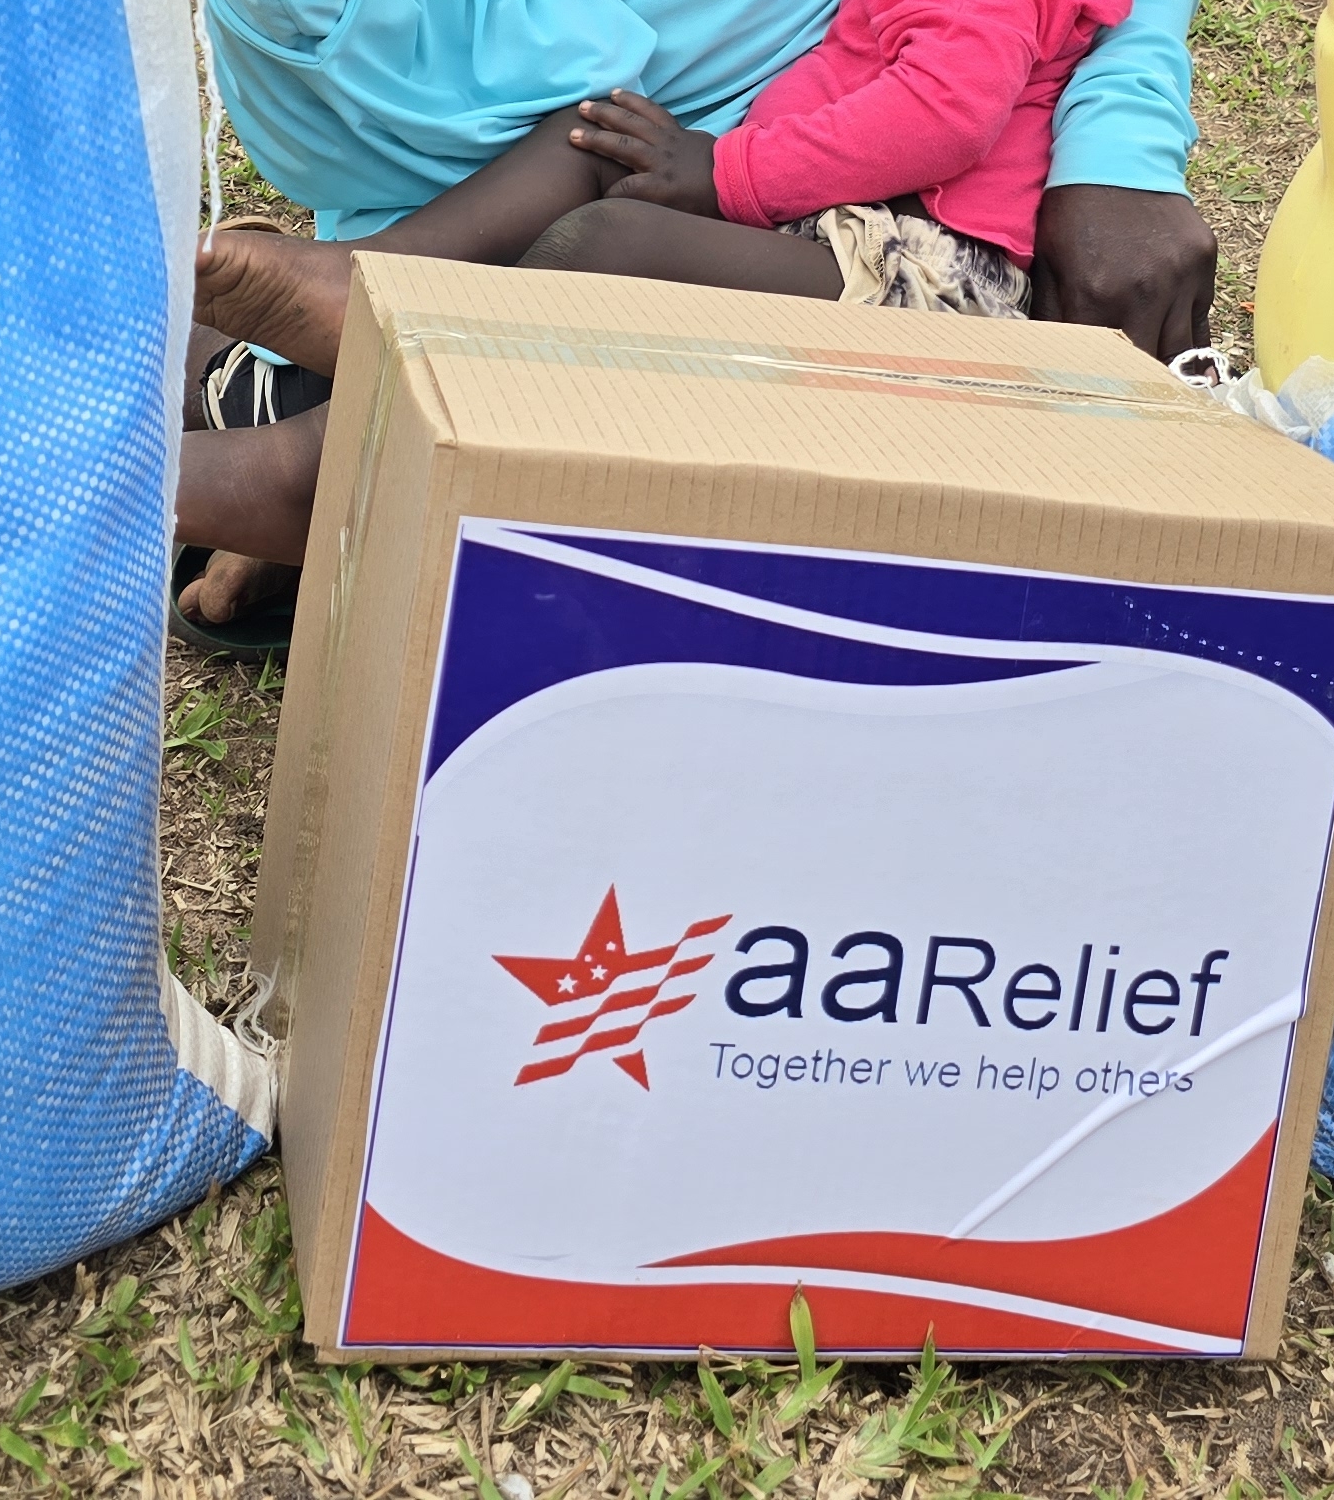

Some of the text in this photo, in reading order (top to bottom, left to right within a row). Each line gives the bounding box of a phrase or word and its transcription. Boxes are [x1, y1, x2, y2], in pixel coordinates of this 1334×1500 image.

[724, 923, 1231, 1038] aaRelief
[709, 1042, 1195, 1100] Together we help others
